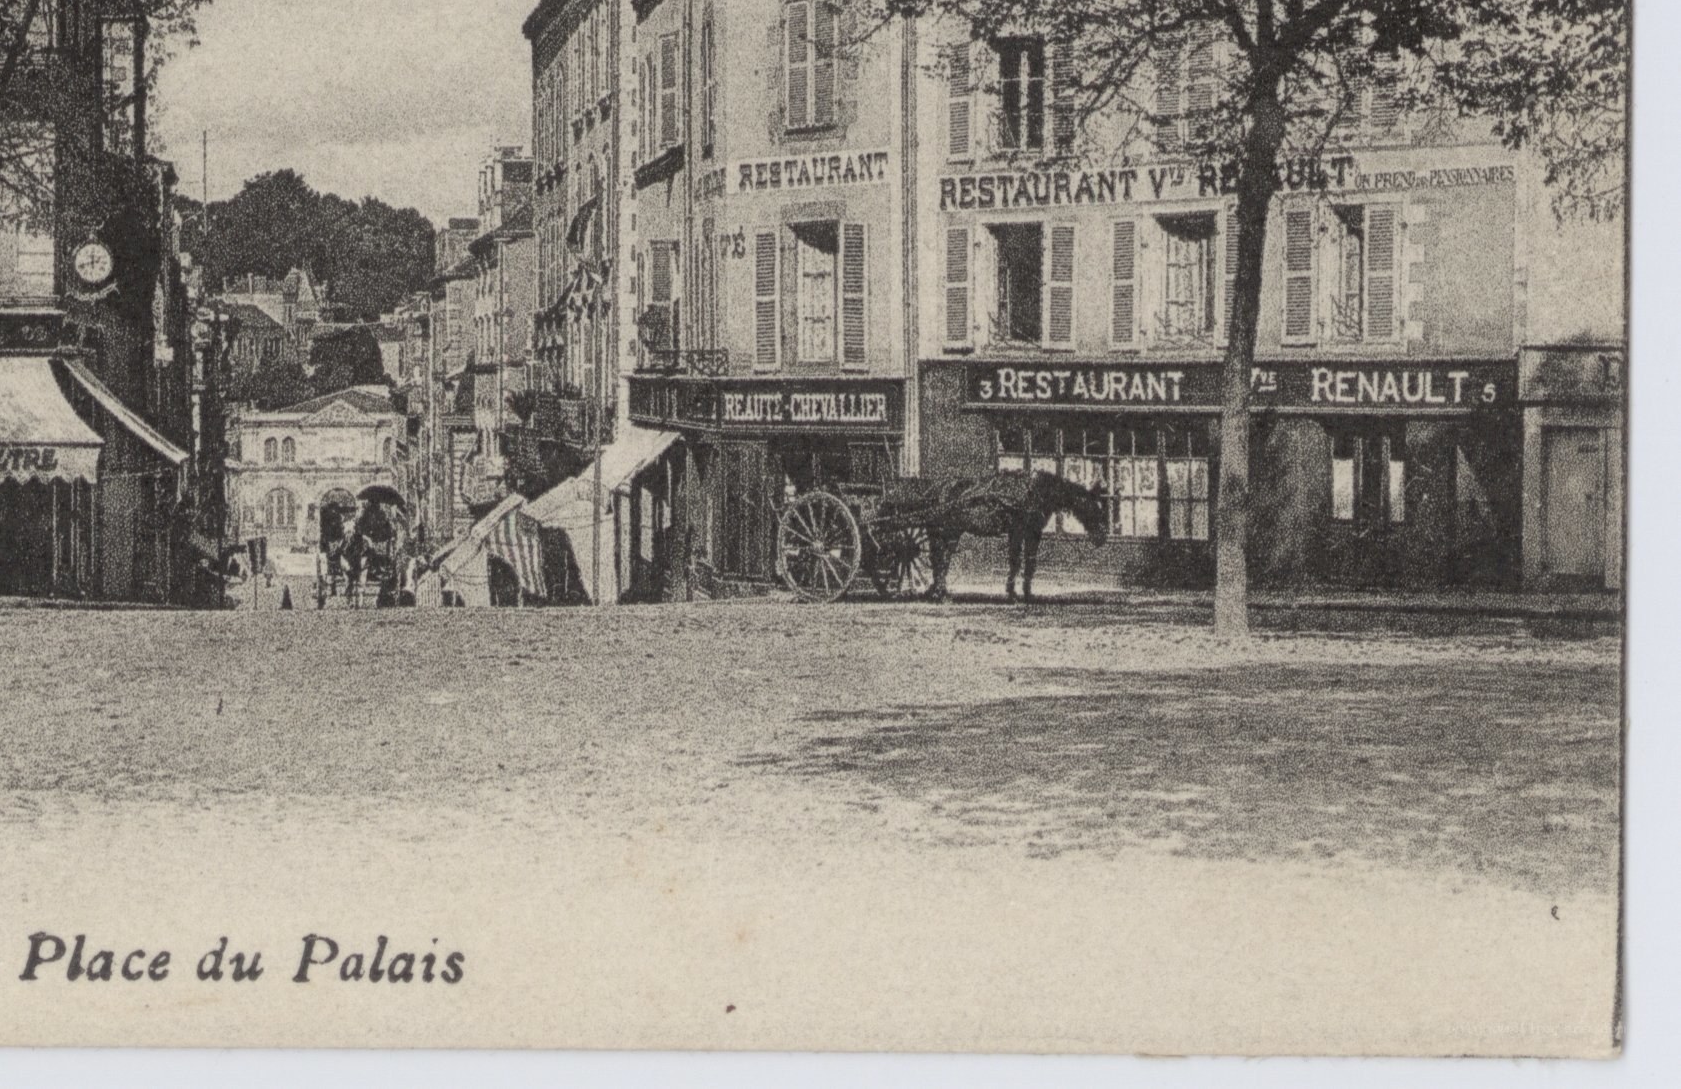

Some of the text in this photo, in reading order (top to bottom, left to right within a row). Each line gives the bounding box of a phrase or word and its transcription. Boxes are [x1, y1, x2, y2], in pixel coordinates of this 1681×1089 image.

[738, 151, 889, 192] RESTAURANT
[939, 170, 1138, 211] RESTAURANT
[997, 368, 1184, 401] RESTAURANT
[1310, 367, 1469, 403] RENAULT
